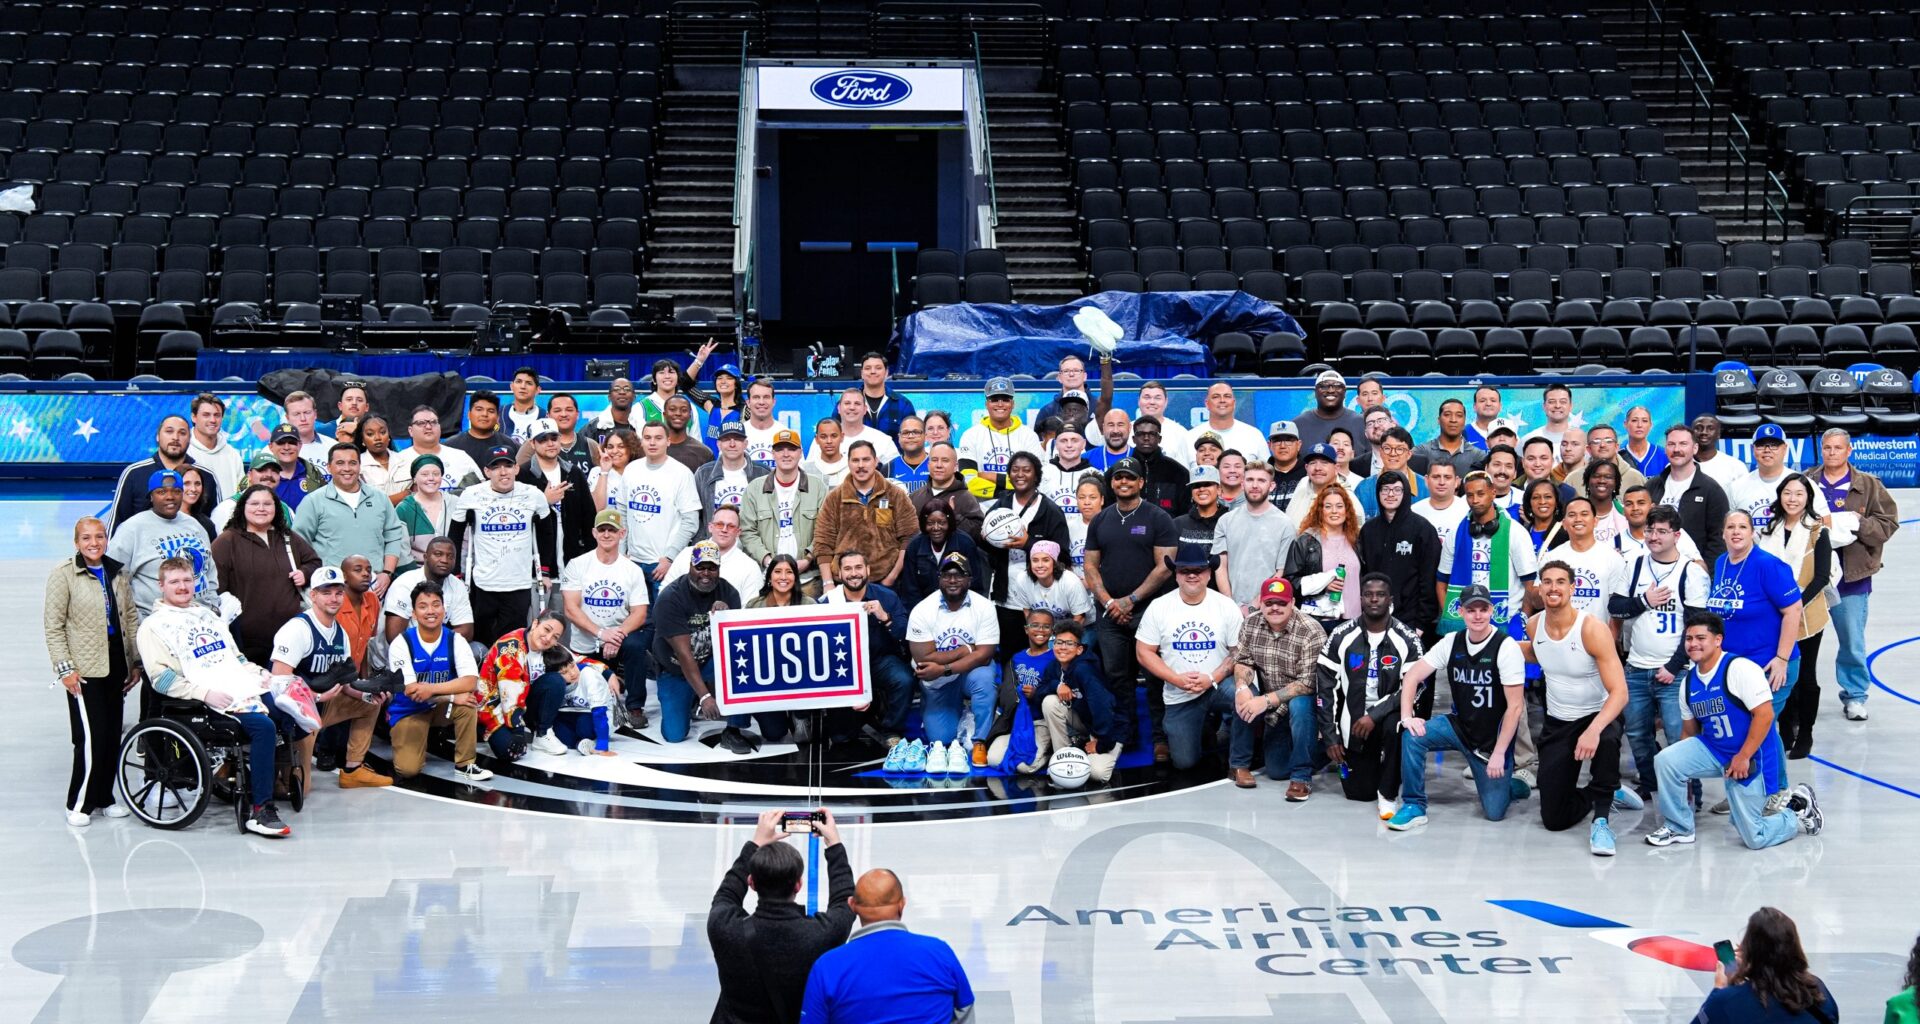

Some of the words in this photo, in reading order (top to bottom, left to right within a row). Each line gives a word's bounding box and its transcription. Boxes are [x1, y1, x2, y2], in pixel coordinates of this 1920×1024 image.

[831, 75, 891, 101] Ford
[1850, 438, 1917, 450] uthwestern
[1854, 451, 1891, 460] Medical
[1892, 451, 1917, 460] Center
[481, 505, 506, 521] SEATS
[509, 505, 525, 520] FOR
[989, 512, 1015, 528] Wilson
[1585, 569, 1600, 585] FOR
[585, 579, 609, 595] SEATS
[611, 582, 625, 597] FOR
[586, 598, 621, 606] HEROES
[1172, 620, 1196, 639] SEATS
[1198, 622, 1215, 638] FOR
[1656, 612, 1677, 634] 31
[937, 627, 957, 645] SEATS
[957, 628, 974, 643] FOR
[1175, 642, 1213, 650] HEROES
[751, 630, 831, 686] USO
[1453, 667, 1493, 685] DALLAS
[1471, 686, 1493, 708] 31
[1710, 714, 1734, 739] 31
[1056, 751, 1084, 760] Wilson
[1005, 902, 1443, 926] American
[1153, 926, 1508, 951] Airlines
[1254, 952, 1574, 977] Center
